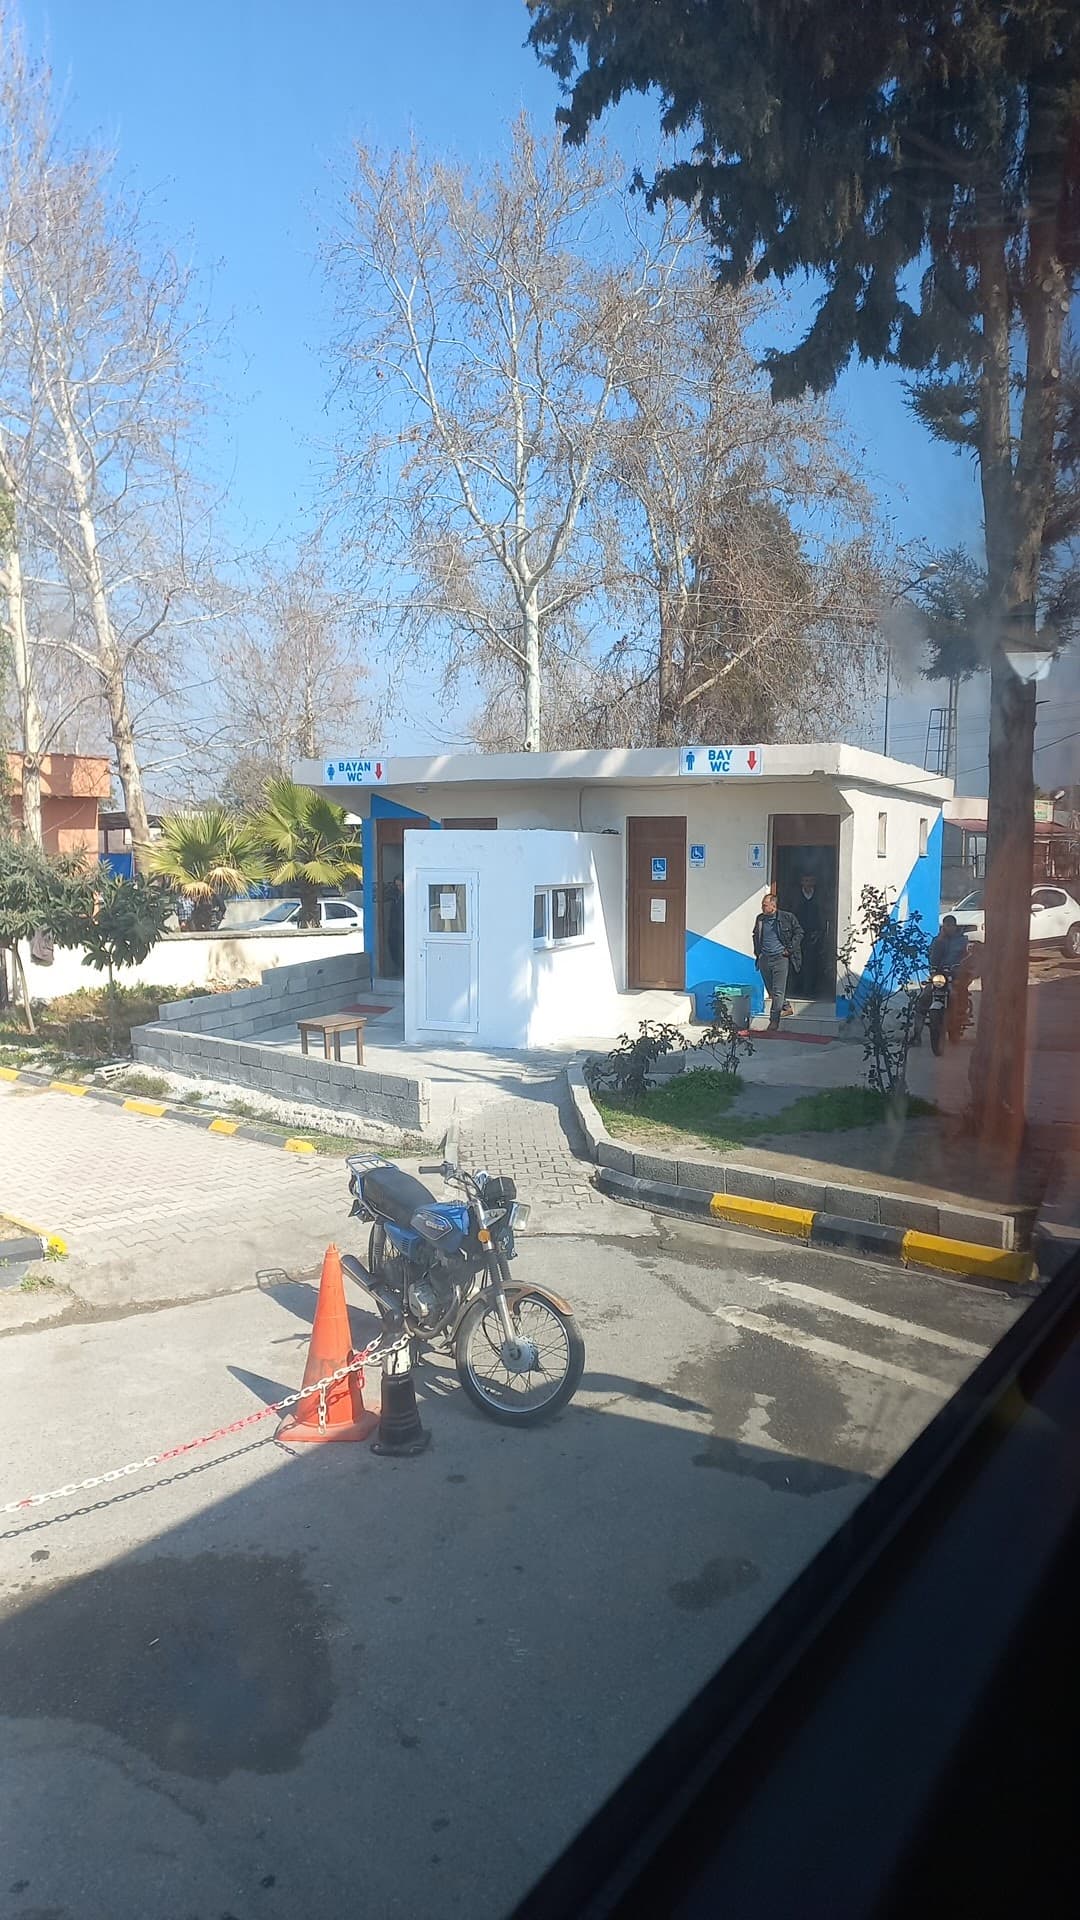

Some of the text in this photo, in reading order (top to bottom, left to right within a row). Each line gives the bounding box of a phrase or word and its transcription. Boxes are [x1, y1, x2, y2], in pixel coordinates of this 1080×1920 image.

[708, 750, 733, 760] BAY
[338, 762, 371, 772] BAYAN
[710, 761, 731, 772] WC
[347, 772, 363, 782] WC
